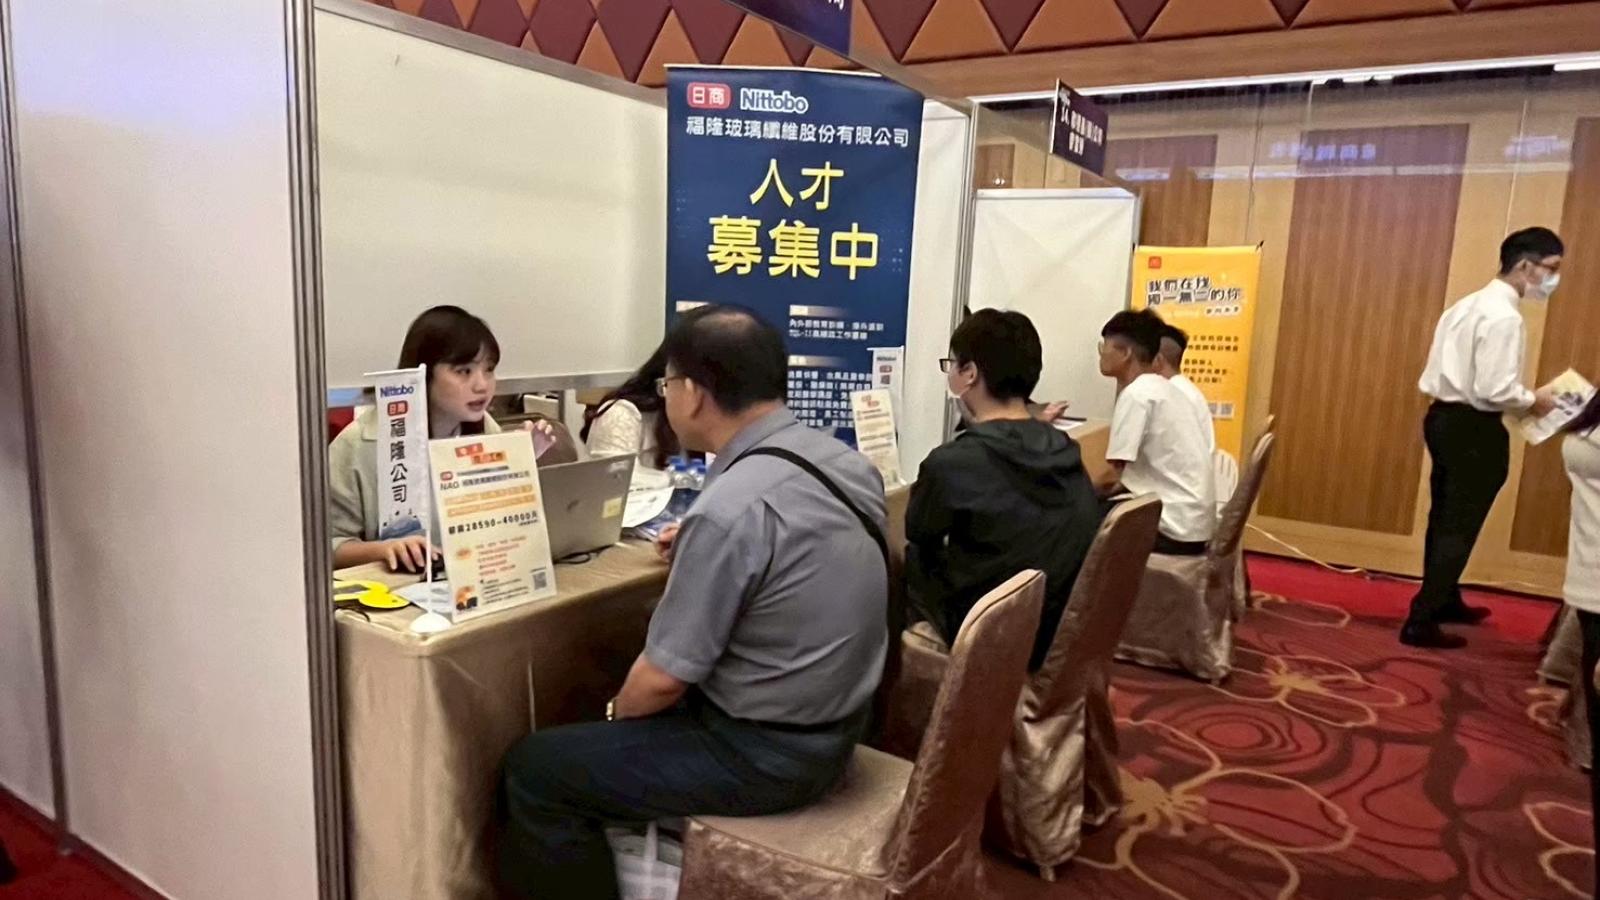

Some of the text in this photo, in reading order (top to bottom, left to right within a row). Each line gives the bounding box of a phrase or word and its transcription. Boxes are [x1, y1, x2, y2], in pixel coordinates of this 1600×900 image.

[692, 87, 809, 114] 日商 Nittobo
[686, 115, 909, 147] 福隆玻璃纖維股份有限公司
[750, 158, 844, 210] 人才
[707, 215, 878, 280] 募集中
[380, 384, 415, 398] Nittobo
[390, 417, 408, 503] 福隆公司
